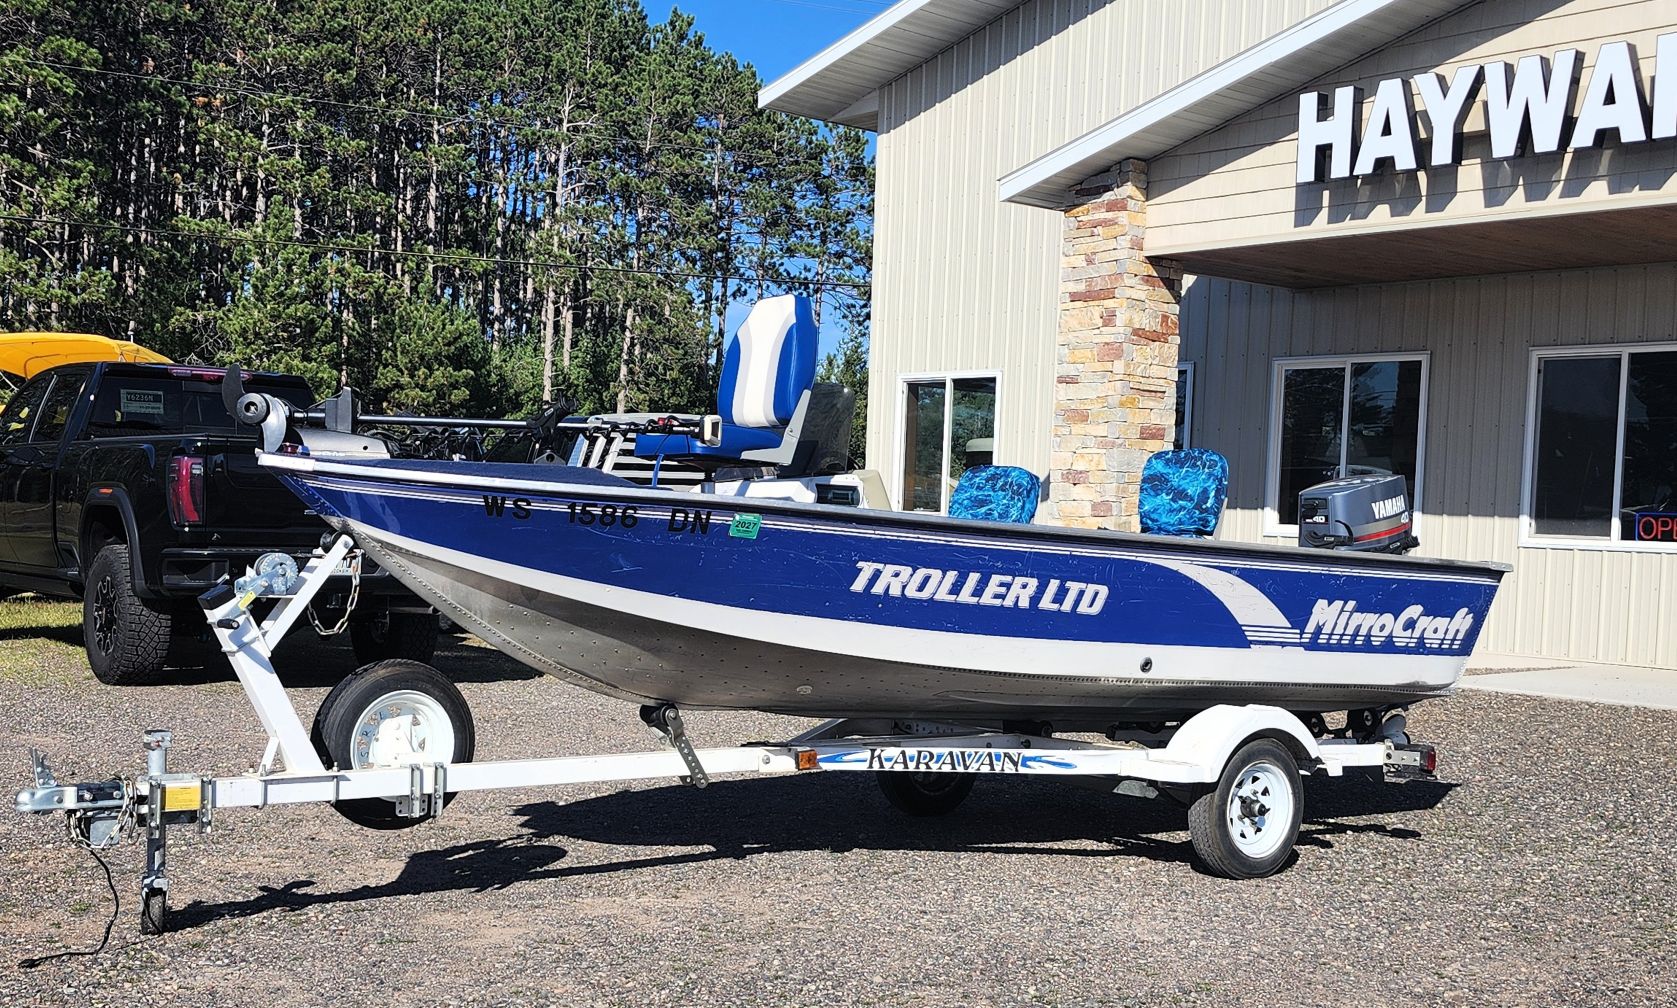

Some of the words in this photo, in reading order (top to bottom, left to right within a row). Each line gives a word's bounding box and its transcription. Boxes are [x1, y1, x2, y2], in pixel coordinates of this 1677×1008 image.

[482, 495, 532, 520] WS
[567, 502, 639, 529] 1586
[667, 508, 712, 535] DN
[1312, 515, 1326, 523] 40
[1371, 494, 1406, 520] YAMAHA
[735, 520, 758, 530] 2027
[1639, 516, 1677, 540] OP
[849, 560, 1039, 609] TROLLER
[1037, 578, 1110, 616] LTD
[1300, 598, 1474, 649] MirroCraft
[867, 748, 1023, 772] KARAVAN
